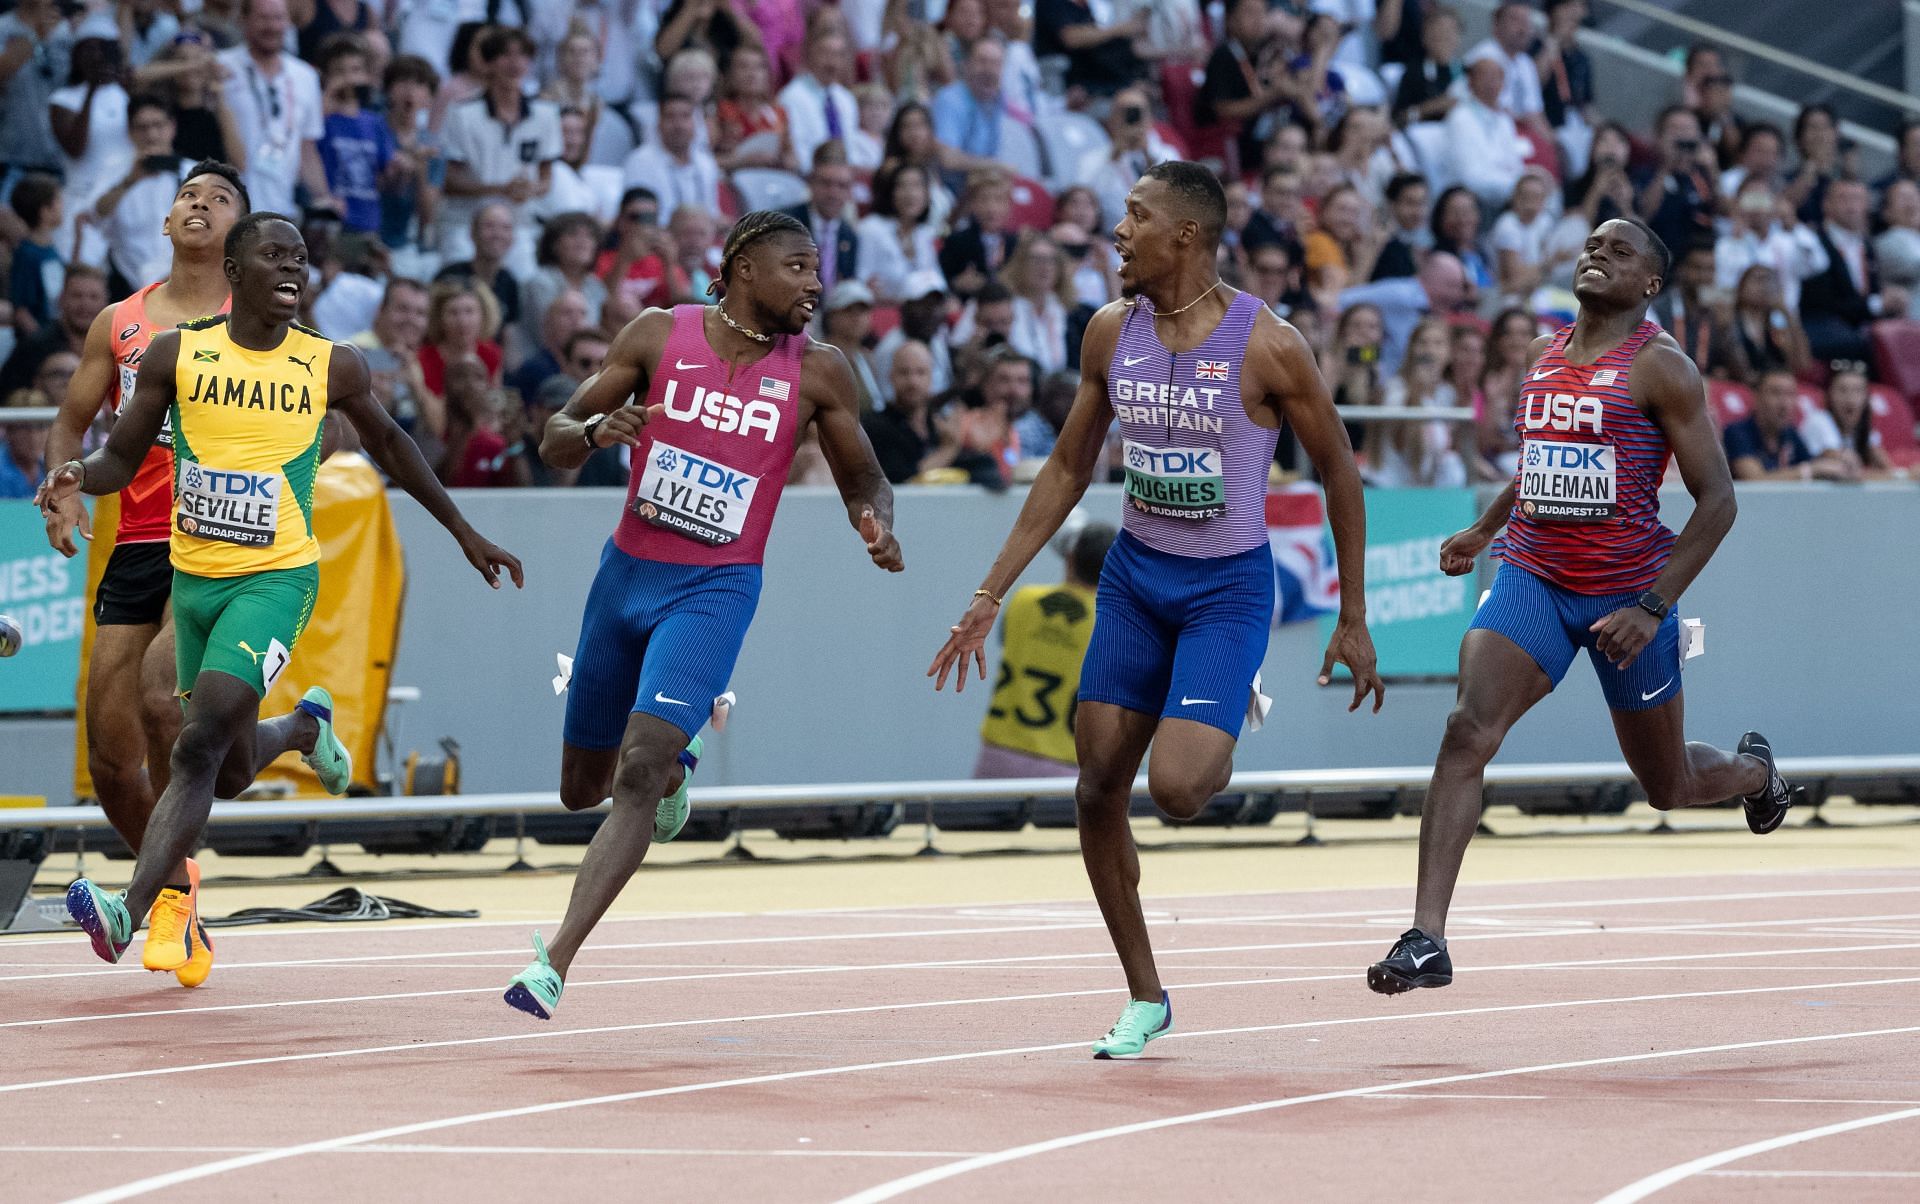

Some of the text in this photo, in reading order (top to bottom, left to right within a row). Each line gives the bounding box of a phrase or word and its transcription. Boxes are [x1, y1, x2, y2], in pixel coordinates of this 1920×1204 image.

[188, 374, 312, 415] JAMAICA
[1116, 379, 1222, 410] GREAT
[664, 379, 781, 443] USA
[1116, 404, 1223, 434] BRITAIN
[1525, 393, 1604, 433] USA
[1143, 449, 1213, 474] TDK
[1542, 444, 1606, 471] TDK
[203, 470, 274, 498] TDK
[680, 453, 751, 500] TDK
[1130, 473, 1216, 503] HUGHES
[1523, 472, 1609, 500] COLEMAN
[182, 491, 272, 527] SEVILLE
[653, 477, 728, 524] LYLES
[1151, 506, 1205, 519] BUDAPEST
[1538, 505, 1608, 516] BUDAPEST 23
[198, 524, 269, 543] BUDAPEST 23
[659, 512, 719, 540] BUDAPEST
[268, 652, 286, 683] 7
